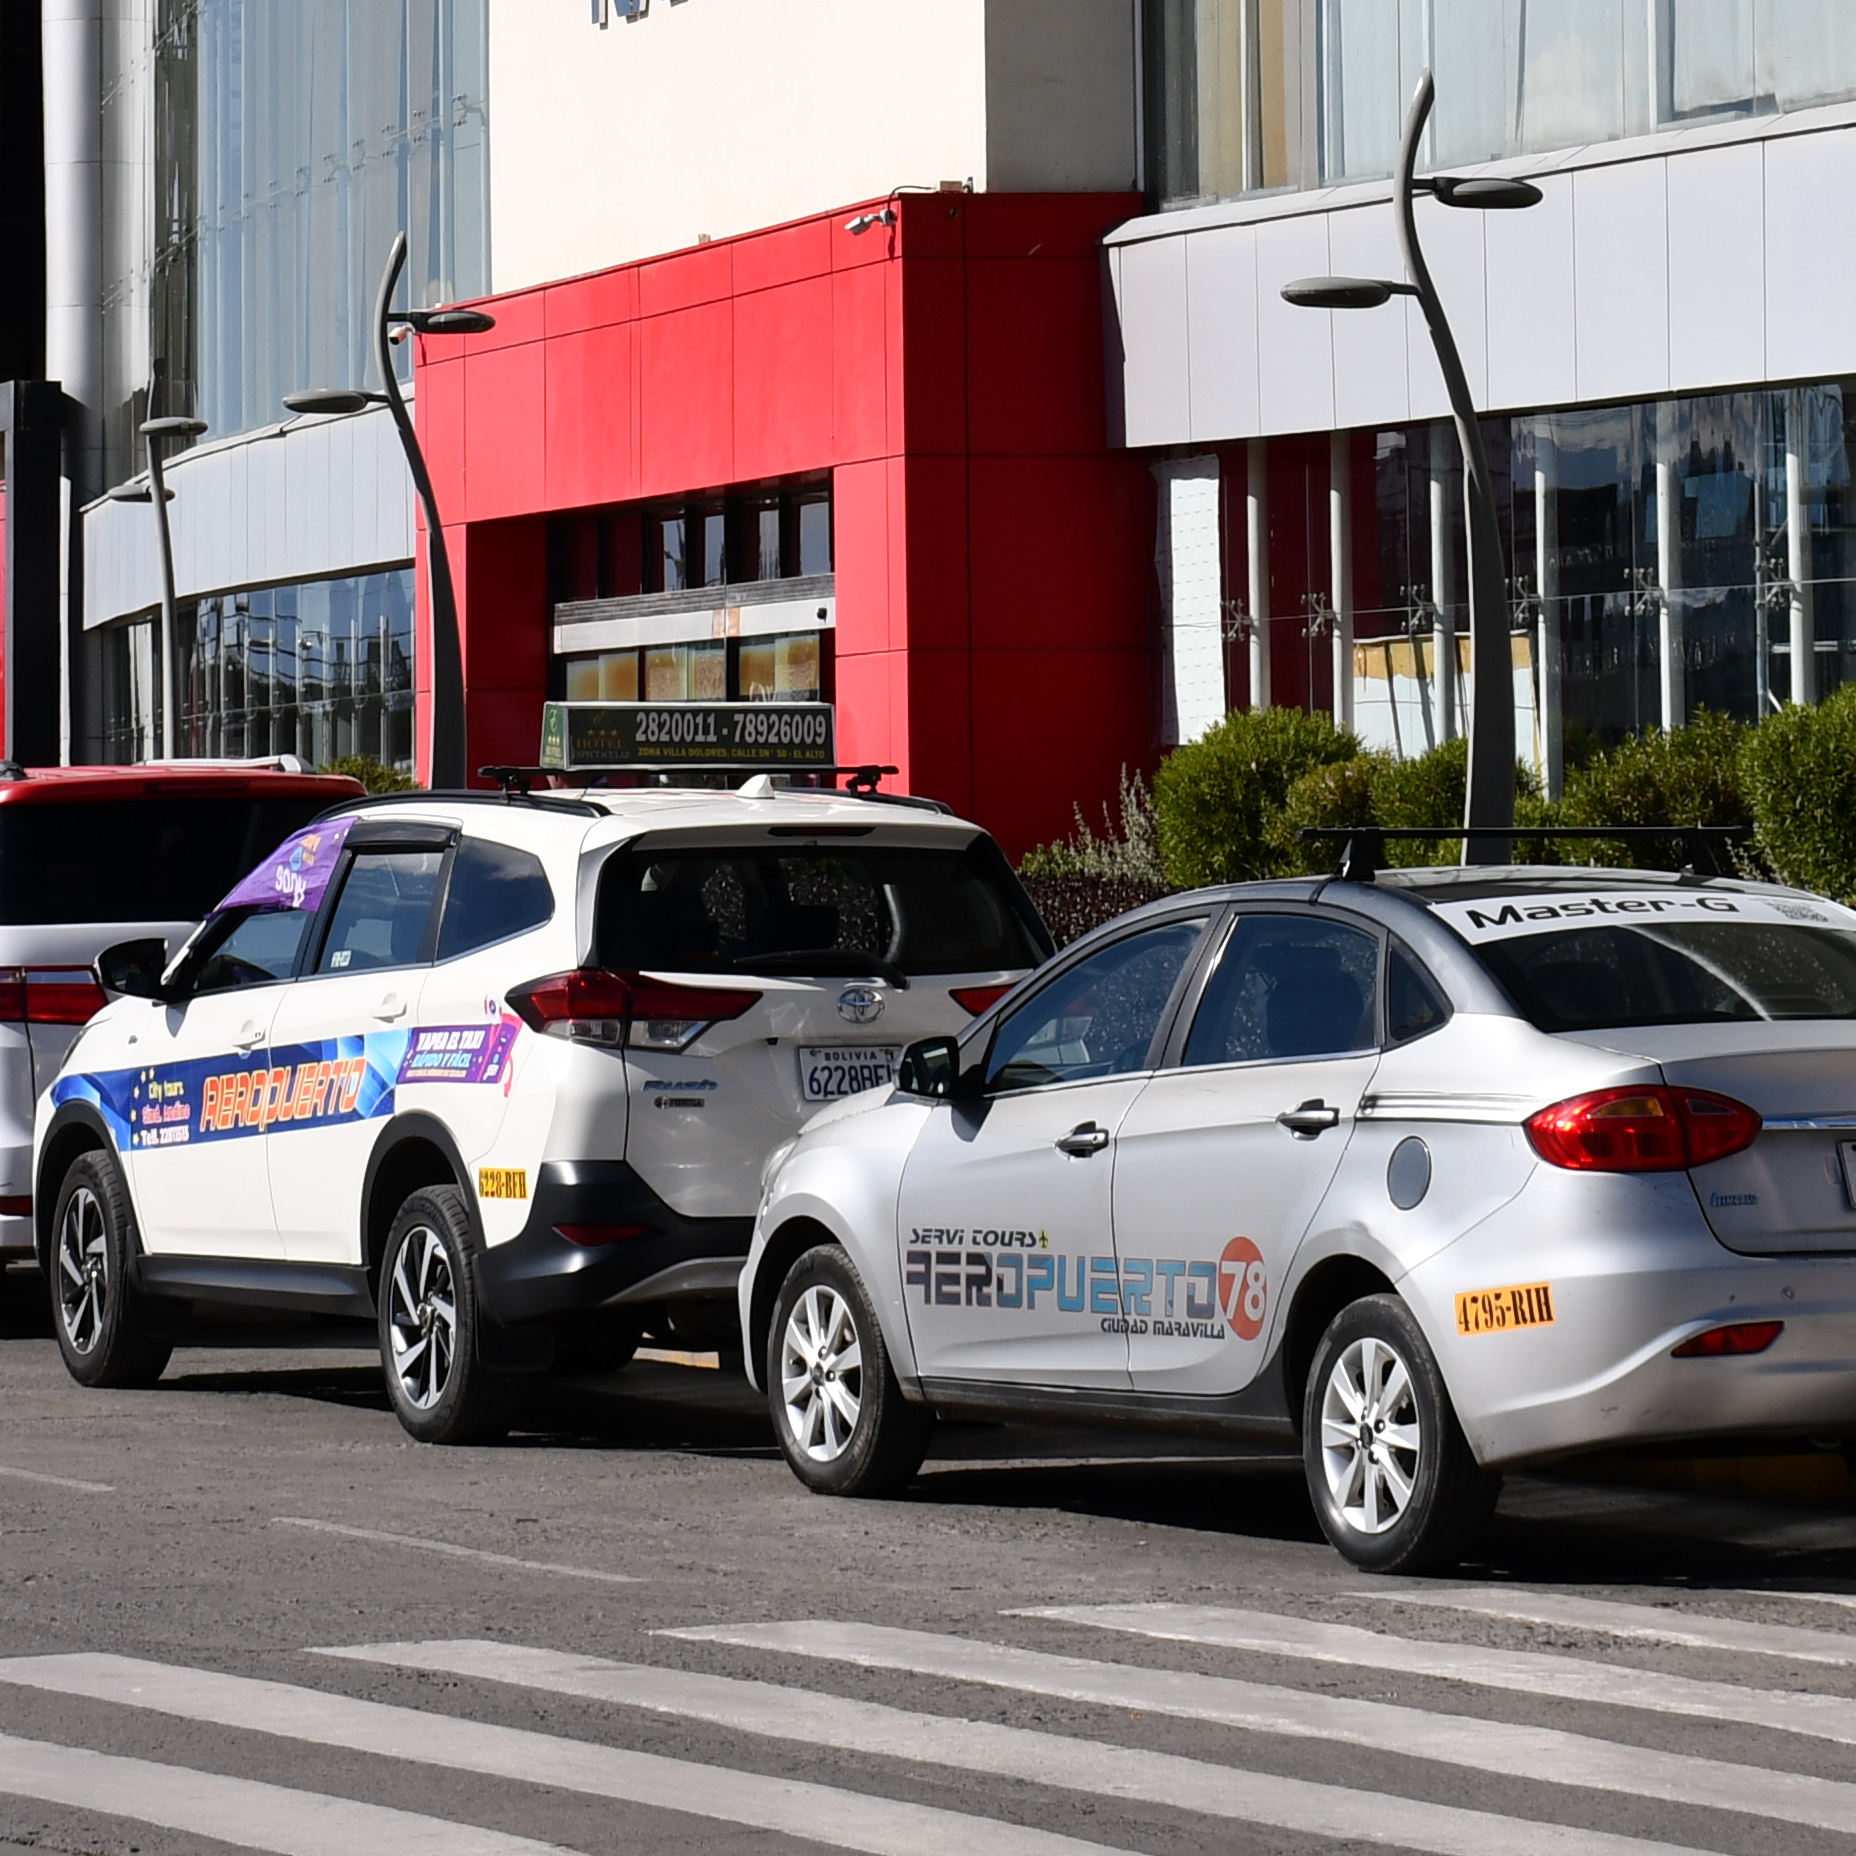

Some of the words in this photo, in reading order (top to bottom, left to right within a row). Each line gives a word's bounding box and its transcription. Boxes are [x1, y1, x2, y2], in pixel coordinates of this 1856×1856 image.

[635, 711, 718, 743] 2820011
[733, 712, 827, 745] 78926009
[576, 738, 624, 749] HOTEL
[638, 747, 661, 757] ZONA
[663, 747, 686, 757] VILLA
[731, 748, 757, 758] CALLE
[793, 749, 803, 759] EL
[805, 750, 826, 760] ALTO
[1464, 896, 1740, 930] Master-G
[824, 1050, 878, 1061] BOLIVIA
[199, 1058, 368, 1133] AEROPUERTO
[642, 1079, 718, 1092] Rush
[971, 1229, 1037, 1248] TOURS
[906, 1249, 1218, 1320] AEROPUERTO
[1221, 1259, 1267, 1322] 78
[1458, 1285, 1554, 1332] 4795-RIH
[1100, 1317, 1149, 1335] CIUDAD
[1153, 1319, 1226, 1340] MARAVILLA
